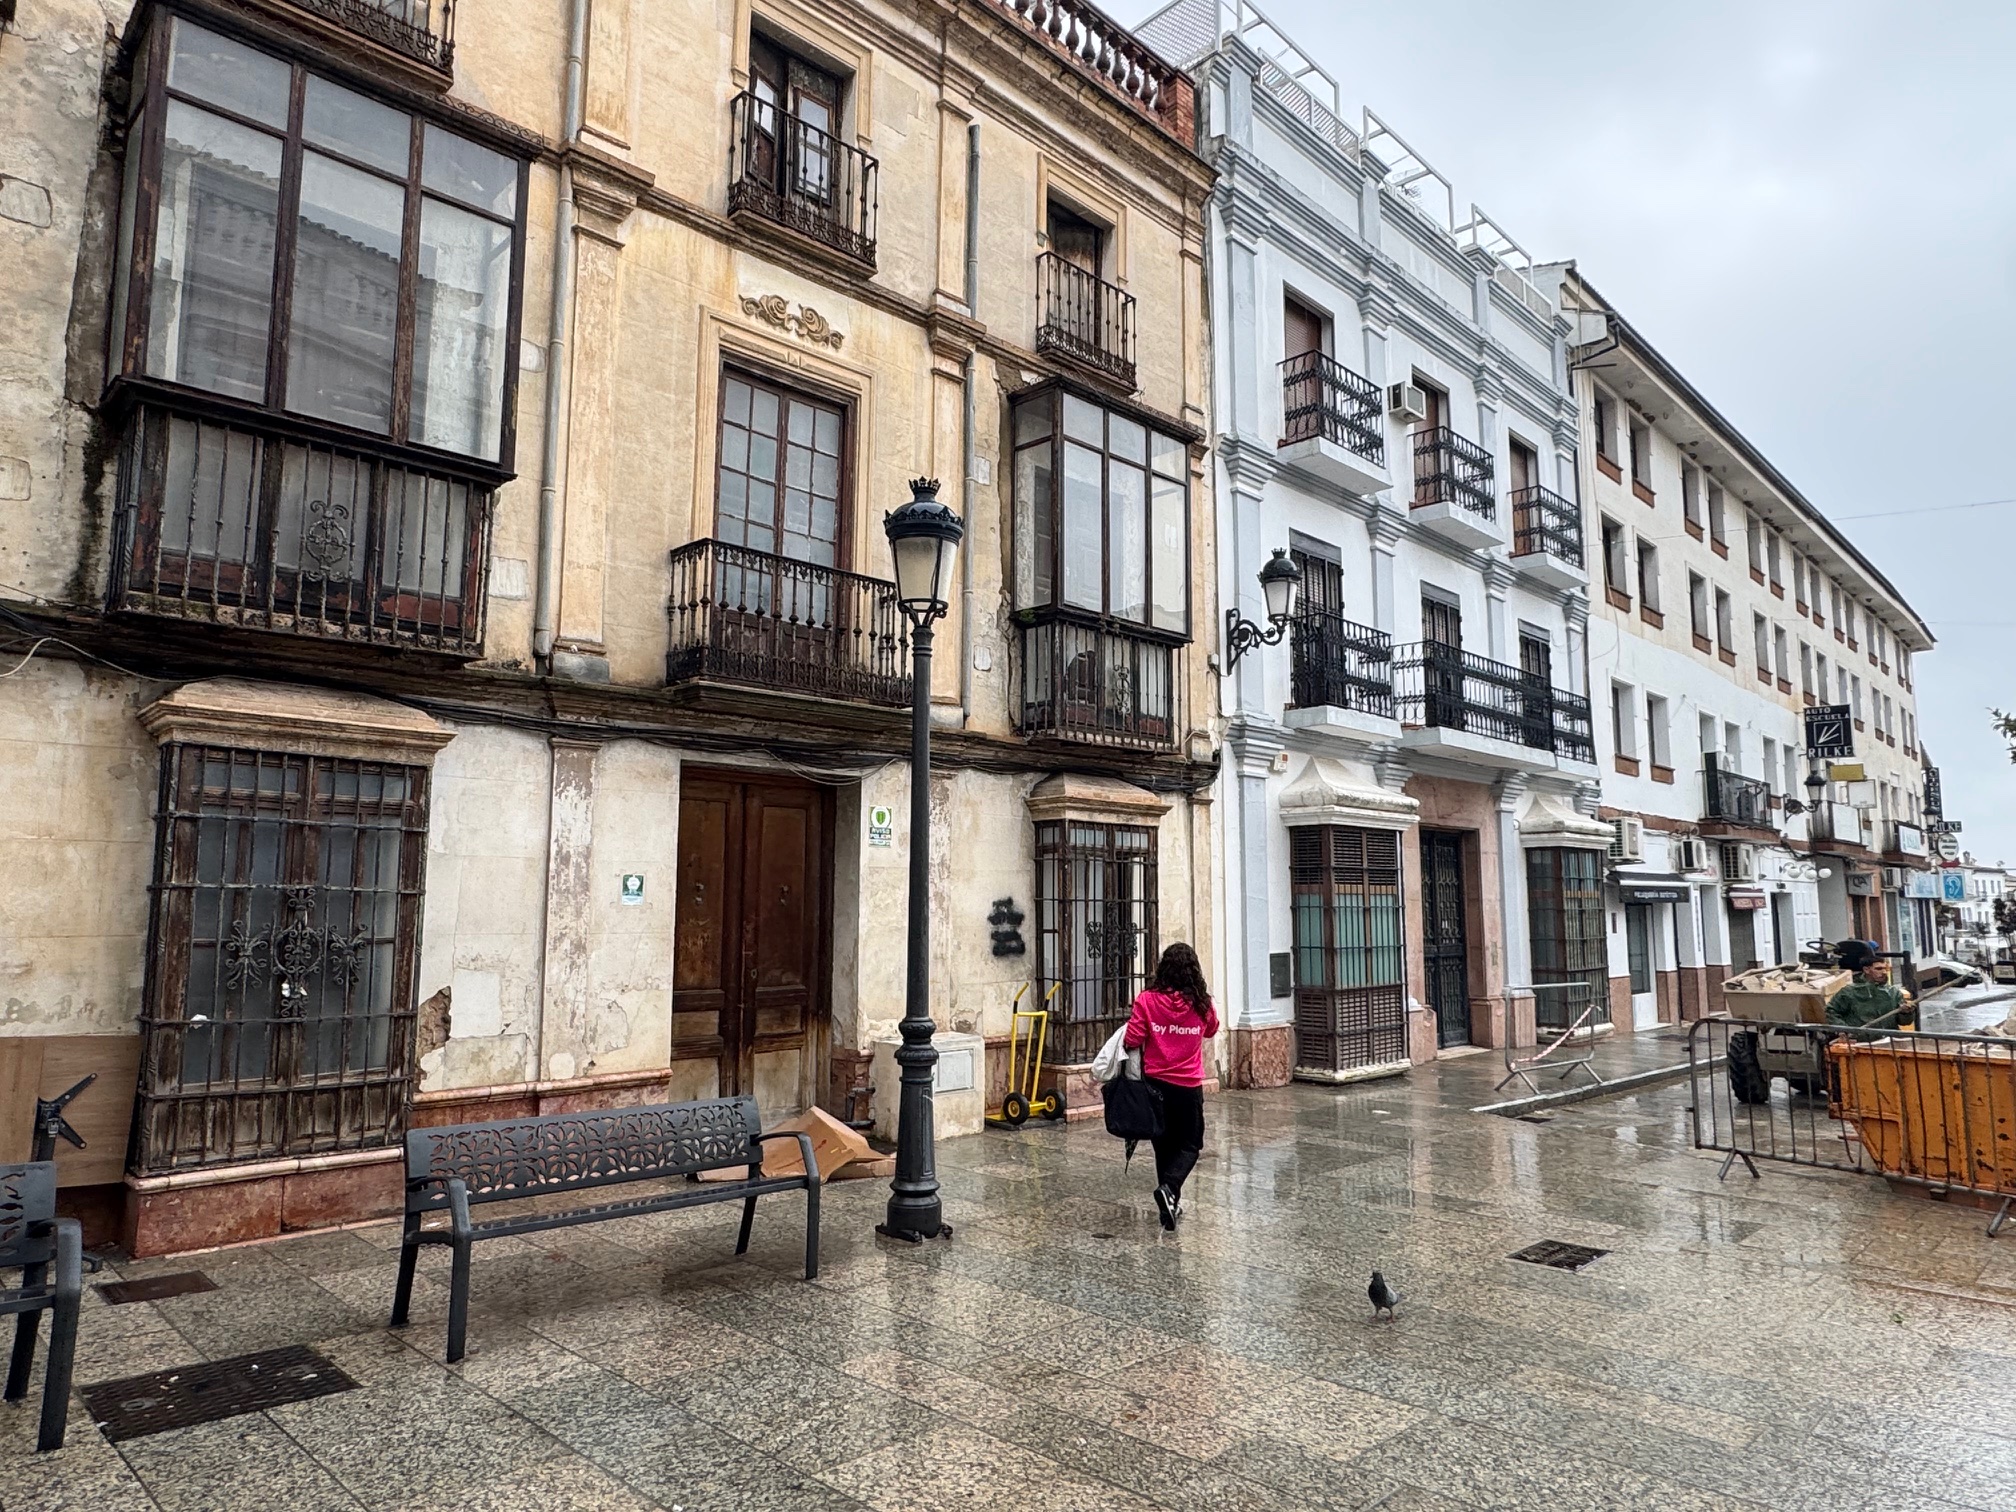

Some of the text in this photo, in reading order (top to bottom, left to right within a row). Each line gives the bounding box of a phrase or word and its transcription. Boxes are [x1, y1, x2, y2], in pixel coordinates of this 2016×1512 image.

[1806, 713, 1850, 721] ESCUELA
[1808, 745, 1852, 758] RILKE
[1169, 1024, 1201, 1035] Planet
